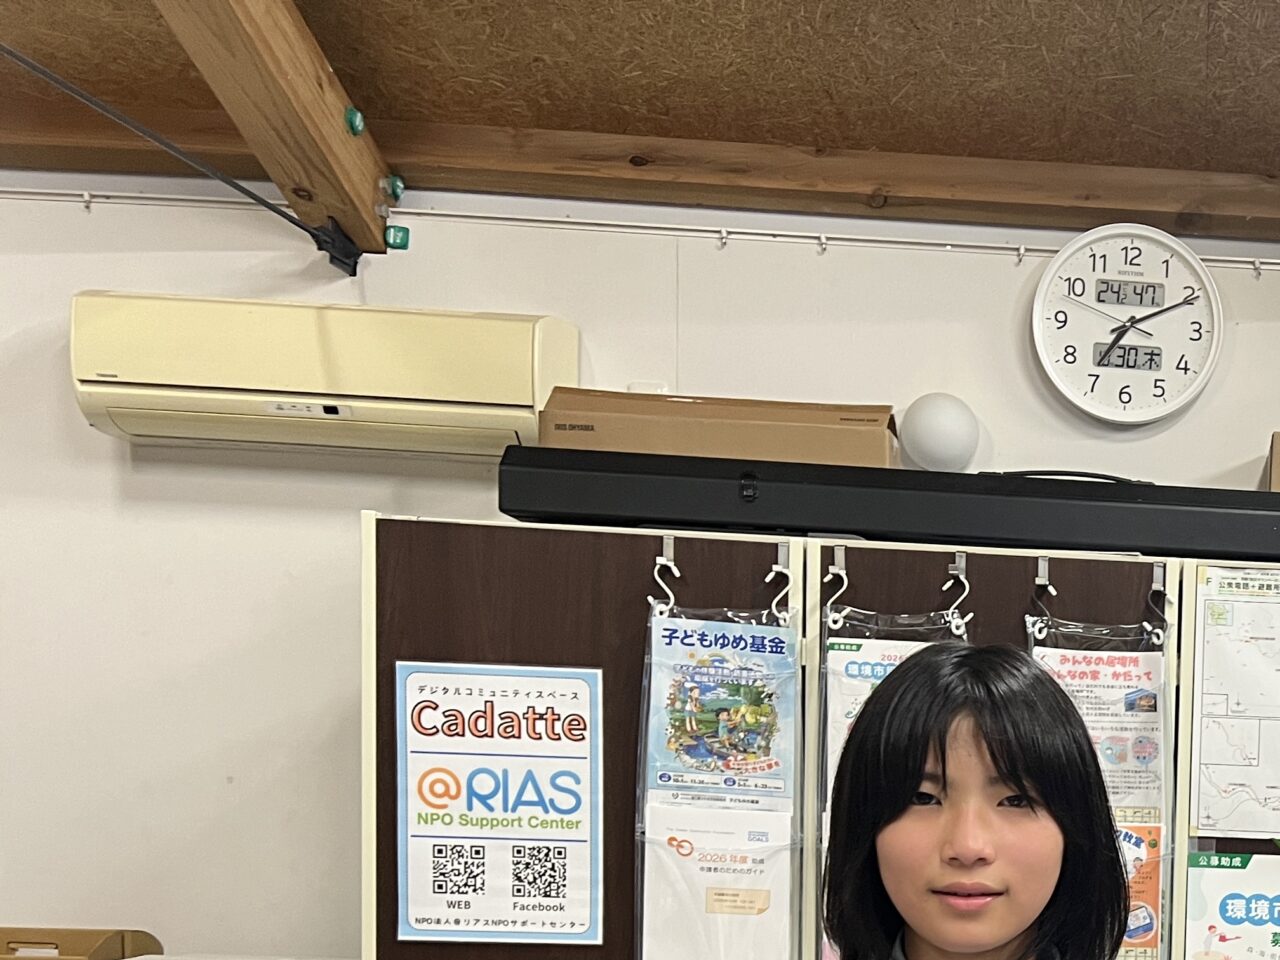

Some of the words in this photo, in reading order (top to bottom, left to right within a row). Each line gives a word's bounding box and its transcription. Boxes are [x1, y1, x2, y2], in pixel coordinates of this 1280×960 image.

[1089, 254, 1107, 273] 11
[1121, 246, 1142, 266] 12
[1162, 259, 1170, 278] 1
[1064, 277, 1085, 297] 10
[1183, 286, 1196, 305] 2
[1054, 311, 1068, 329] 9
[1189, 321, 1202, 341] 3
[1063, 345, 1077, 364] 8
[1142, 350, 1160, 370] 木
[1176, 354, 1190, 375] 4
[1088, 374, 1100, 393] 7
[1153, 379, 1165, 398] 5
[1118, 385, 1132, 404] 6
[662, 628, 785, 654] 子どもゆめ基金
[411, 700, 587, 742] Cadatte
[417, 813, 453, 826] NPO
[459, 814, 522, 830] Support
[528, 816, 582, 829] Center
[1198, 856, 1242, 868] 公募助成
[446, 900, 471, 910] WEB
[513, 902, 565, 912] Facebook
